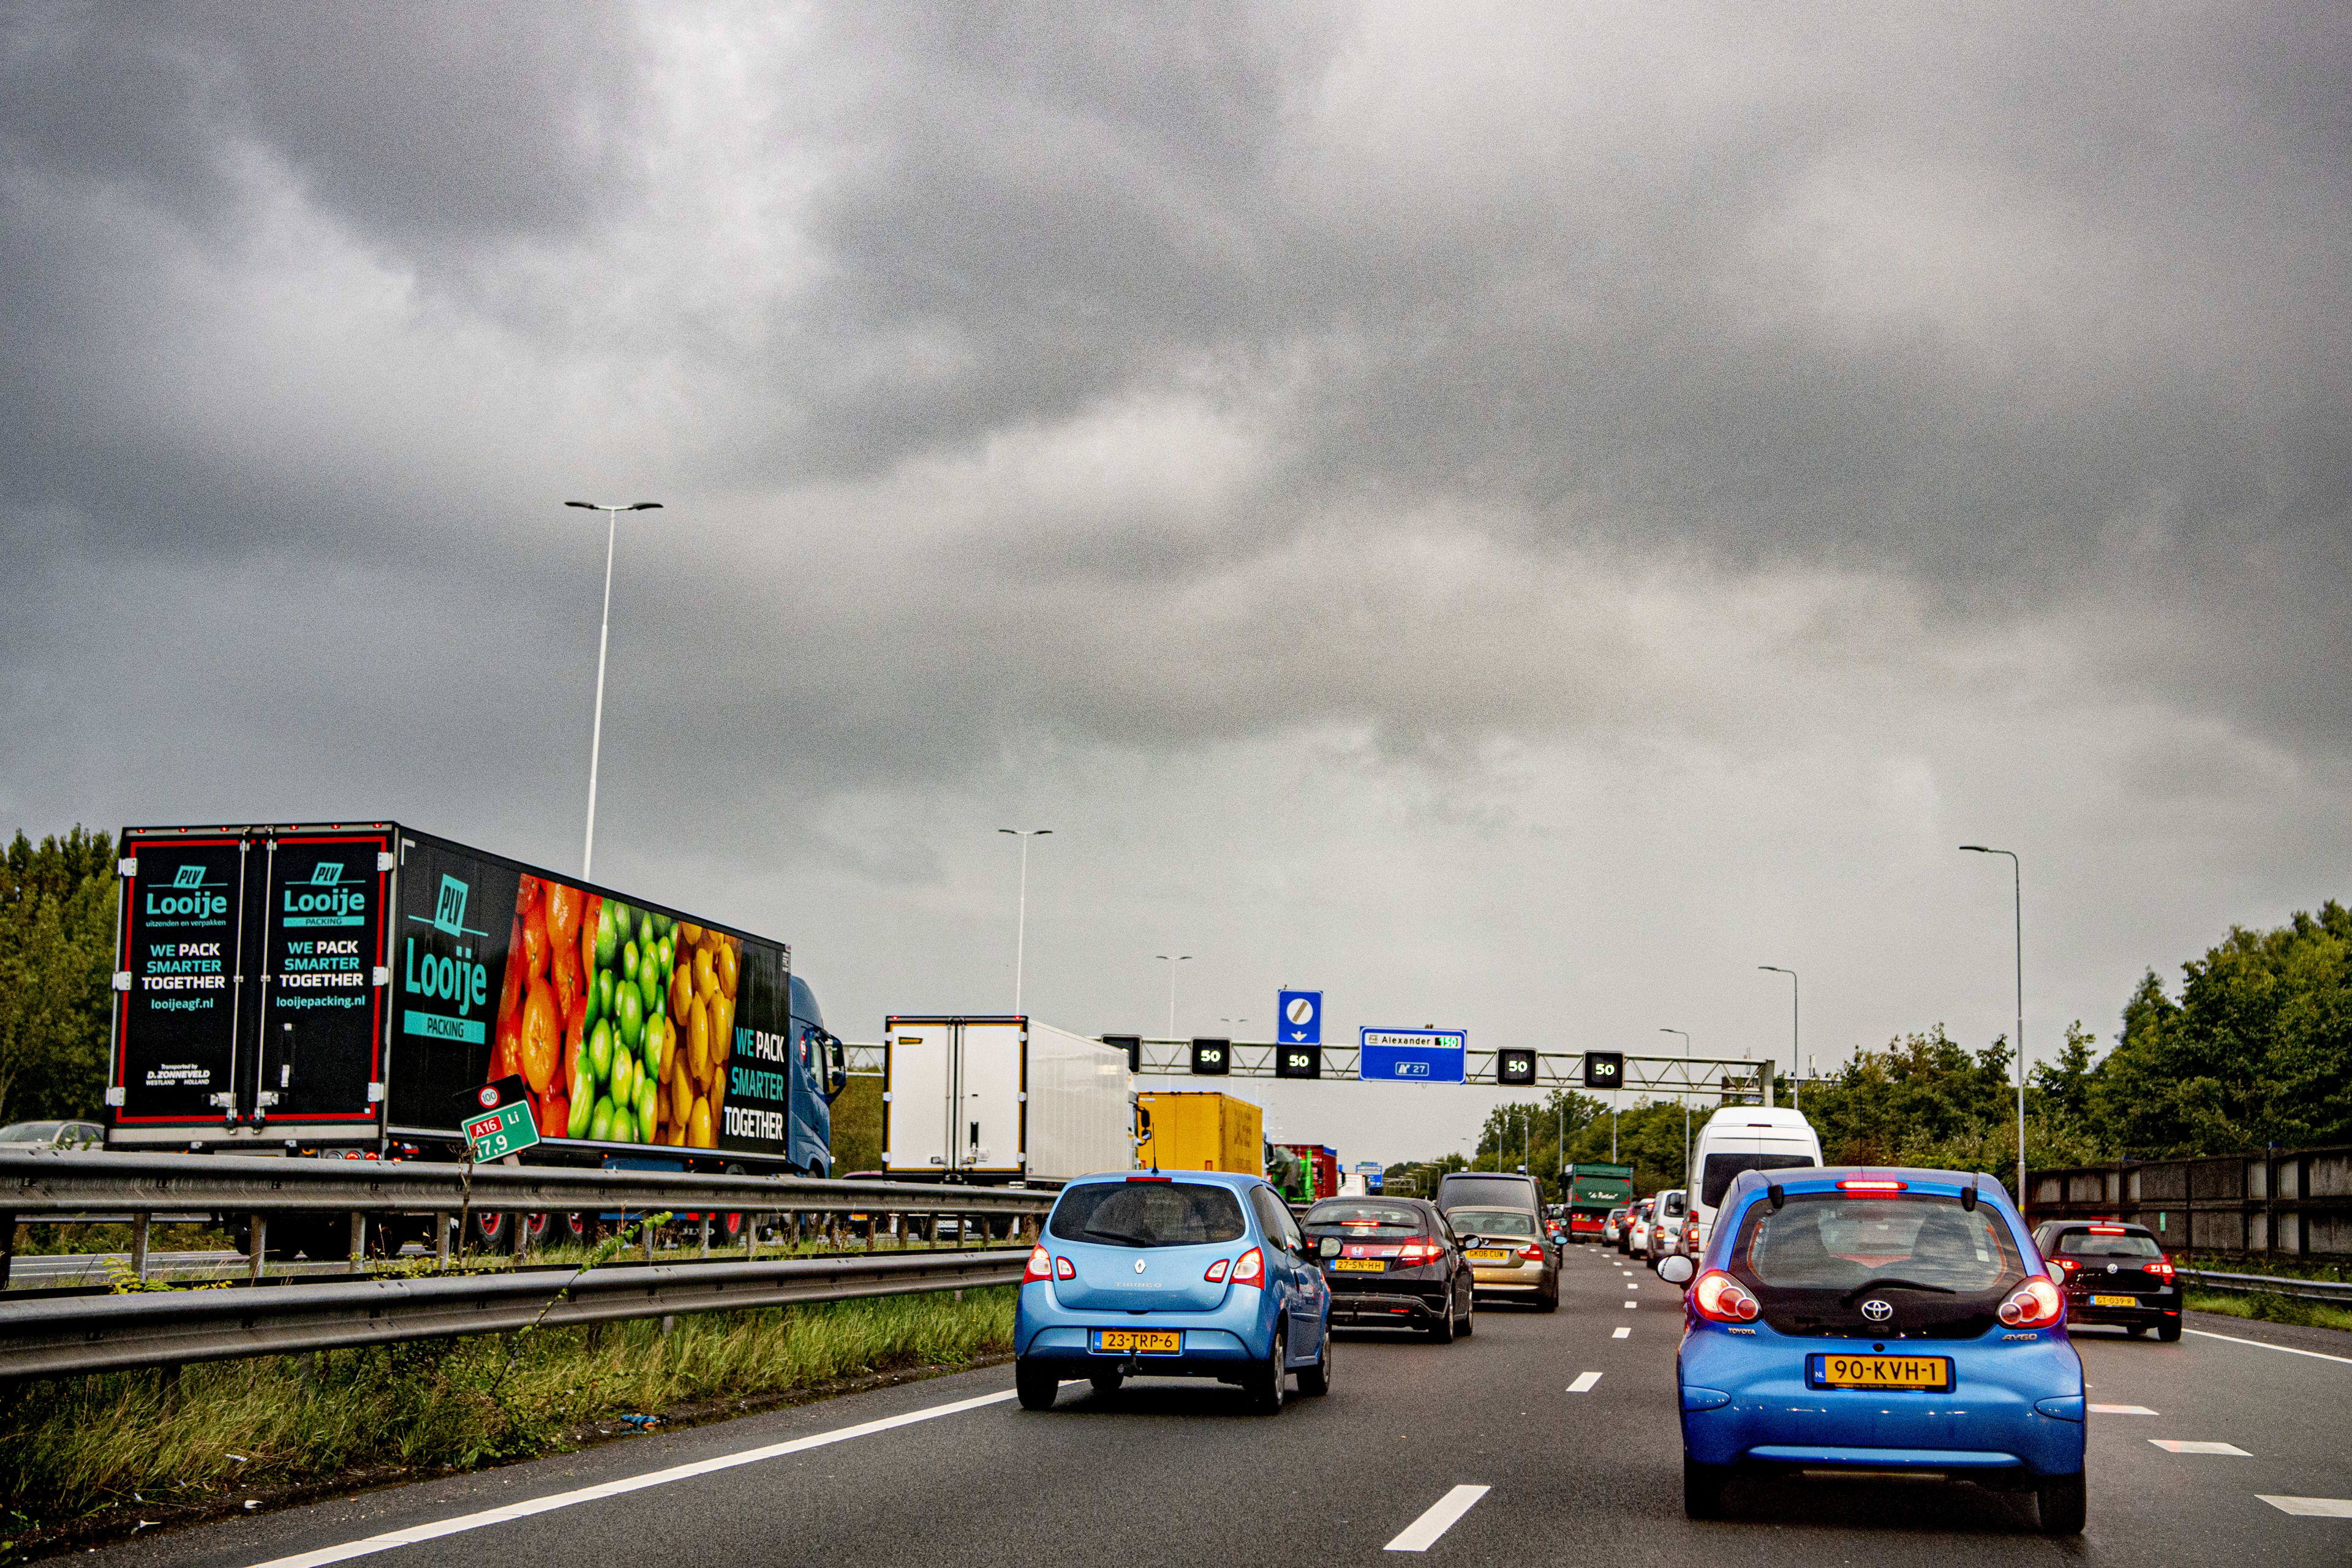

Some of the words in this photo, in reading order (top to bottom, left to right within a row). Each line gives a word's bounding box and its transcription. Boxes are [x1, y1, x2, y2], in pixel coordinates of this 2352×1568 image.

[178, 870, 202, 884] PLV
[315, 867, 339, 881] PLV
[146, 891, 227, 919] Looije
[284, 888, 365, 916] Looije
[439, 884, 464, 925] PLV
[190, 919, 226, 928] verpakken
[150, 944, 175, 957] WE
[179, 943, 221, 956] PACK
[288, 941, 313, 954] WE
[317, 940, 358, 954] PACK
[146, 960, 222, 973] SMARTER
[284, 957, 360, 971] SMARTER
[141, 976, 225, 990] TOGETHER
[279, 973, 363, 987] TOGETHER
[405, 937, 487, 1016] Looije
[151, 997, 214, 1011] looijeagf.nl
[276, 995, 366, 1009] looijepacking.nl
[427, 1017, 464, 1038] PACKING
[736, 1027, 754, 1057] WE
[756, 1030, 784, 1063] PACK
[1381, 1036, 1431, 1045] Alexander
[1439, 1037, 1457, 1047] 150
[1200, 1050, 1221, 1062] 50
[1289, 1055, 1309, 1067] 50
[1509, 1060, 1528, 1072] 50
[1595, 1063, 1615, 1076] 50
[731, 1066, 783, 1101] SMARTER
[482, 1091, 497, 1102] 100
[476, 1120, 497, 1136] A16
[507, 1111, 520, 1125] Li
[724, 1106, 783, 1140] TOGETHER
[1338, 1261, 1381, 1270] 27-SN-HH
[1108, 1333, 1172, 1348] 23-TRP-6
[1835, 1360, 1936, 1381] 90-KVH-1
